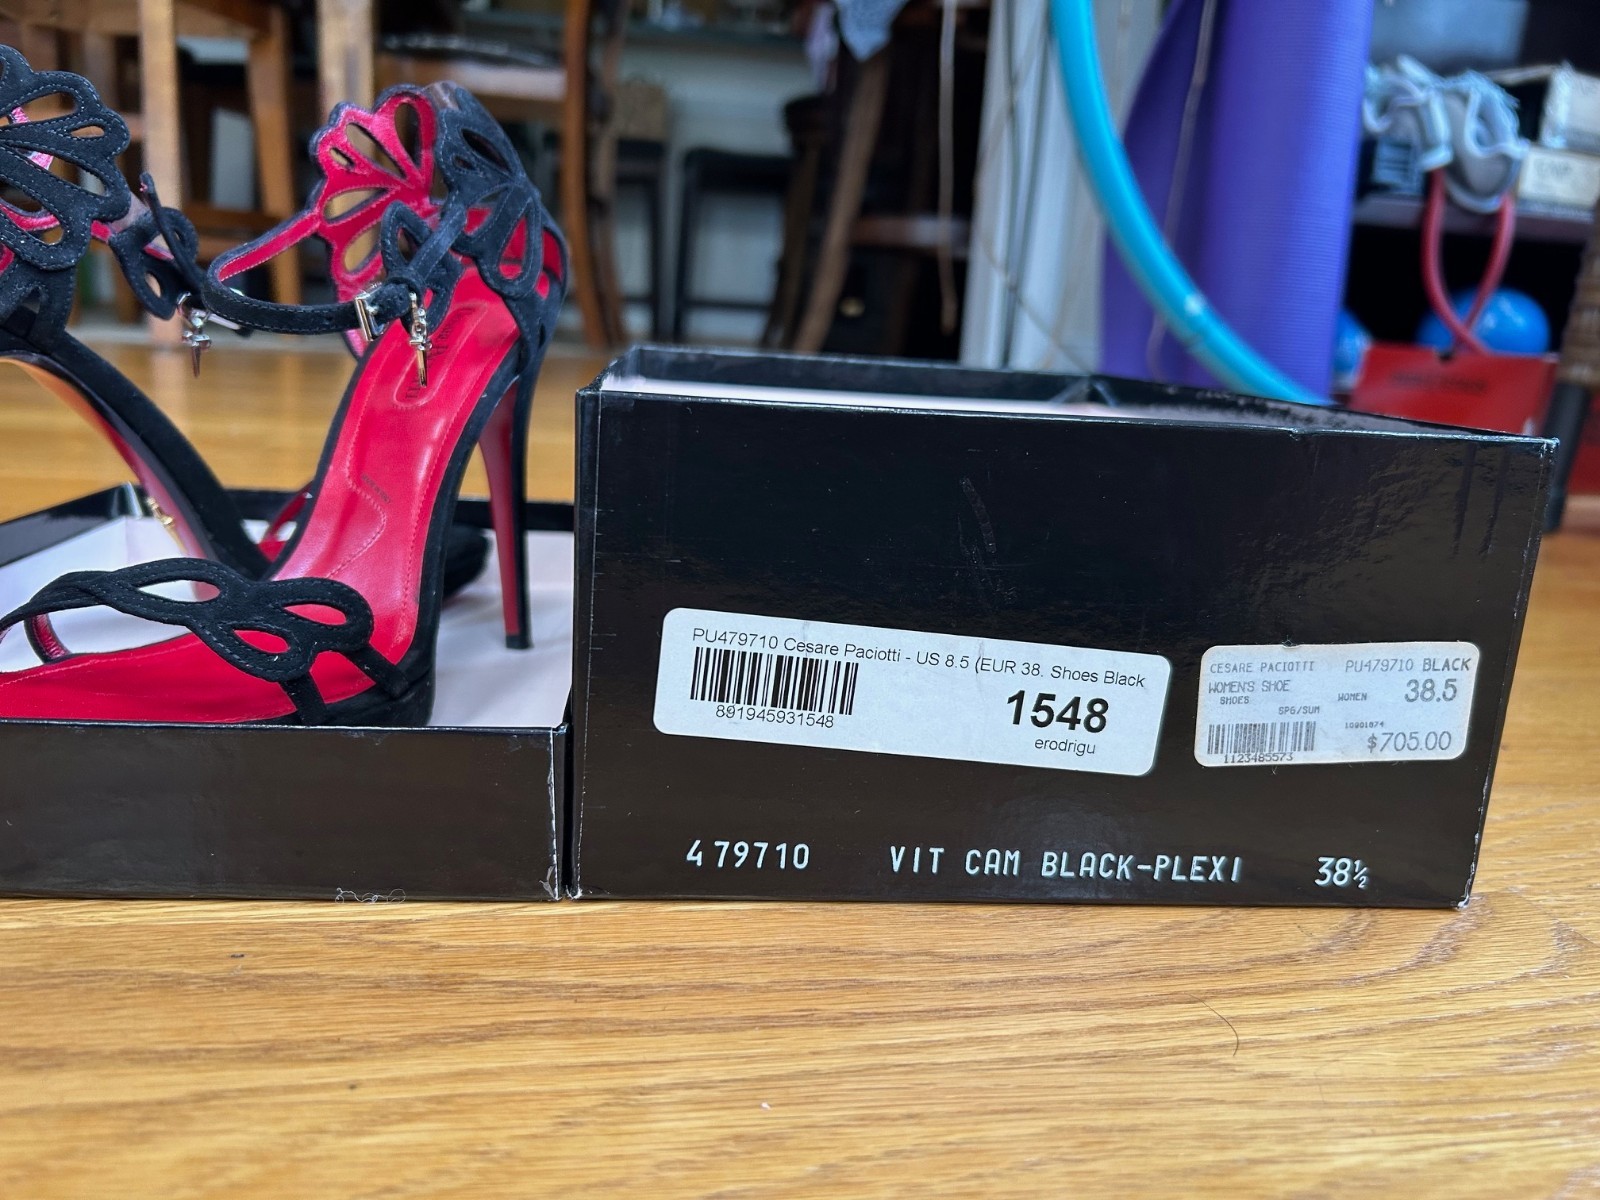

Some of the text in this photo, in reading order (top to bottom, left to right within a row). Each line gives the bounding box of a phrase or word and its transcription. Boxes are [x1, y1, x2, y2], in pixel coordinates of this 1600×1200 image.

[692, 627, 779, 649] PU479710
[783, 637, 839, 656] Cesare
[843, 644, 901, 663] Paciotti
[916, 652, 940, 666] US
[945, 654, 970, 669] 8.5
[975, 657, 1017, 675] (EUR
[1021, 663, 1044, 678] 38.
[1050, 665, 1098, 682] Shoes
[1103, 671, 1145, 687] Black
[1210, 658, 1471, 674] CESARE PACIOTTI PU479710 BLACK
[1208, 680, 1291, 693] WOMEN'S SHOE
[1338, 692, 1367, 702] WOMEN
[1404, 678, 1458, 702] 38.5
[1006, 689, 1109, 733] 1548
[1220, 696, 1250, 705] SHOES
[715, 704, 834, 728] 891945931548
[1034, 738, 1096, 756] erodrigu
[1367, 731, 1452, 754] $705.00
[890, 845, 945, 874] VIT
[965, 849, 1020, 876] CAM
[1042, 851, 1242, 883] BLACK-PLEXI
